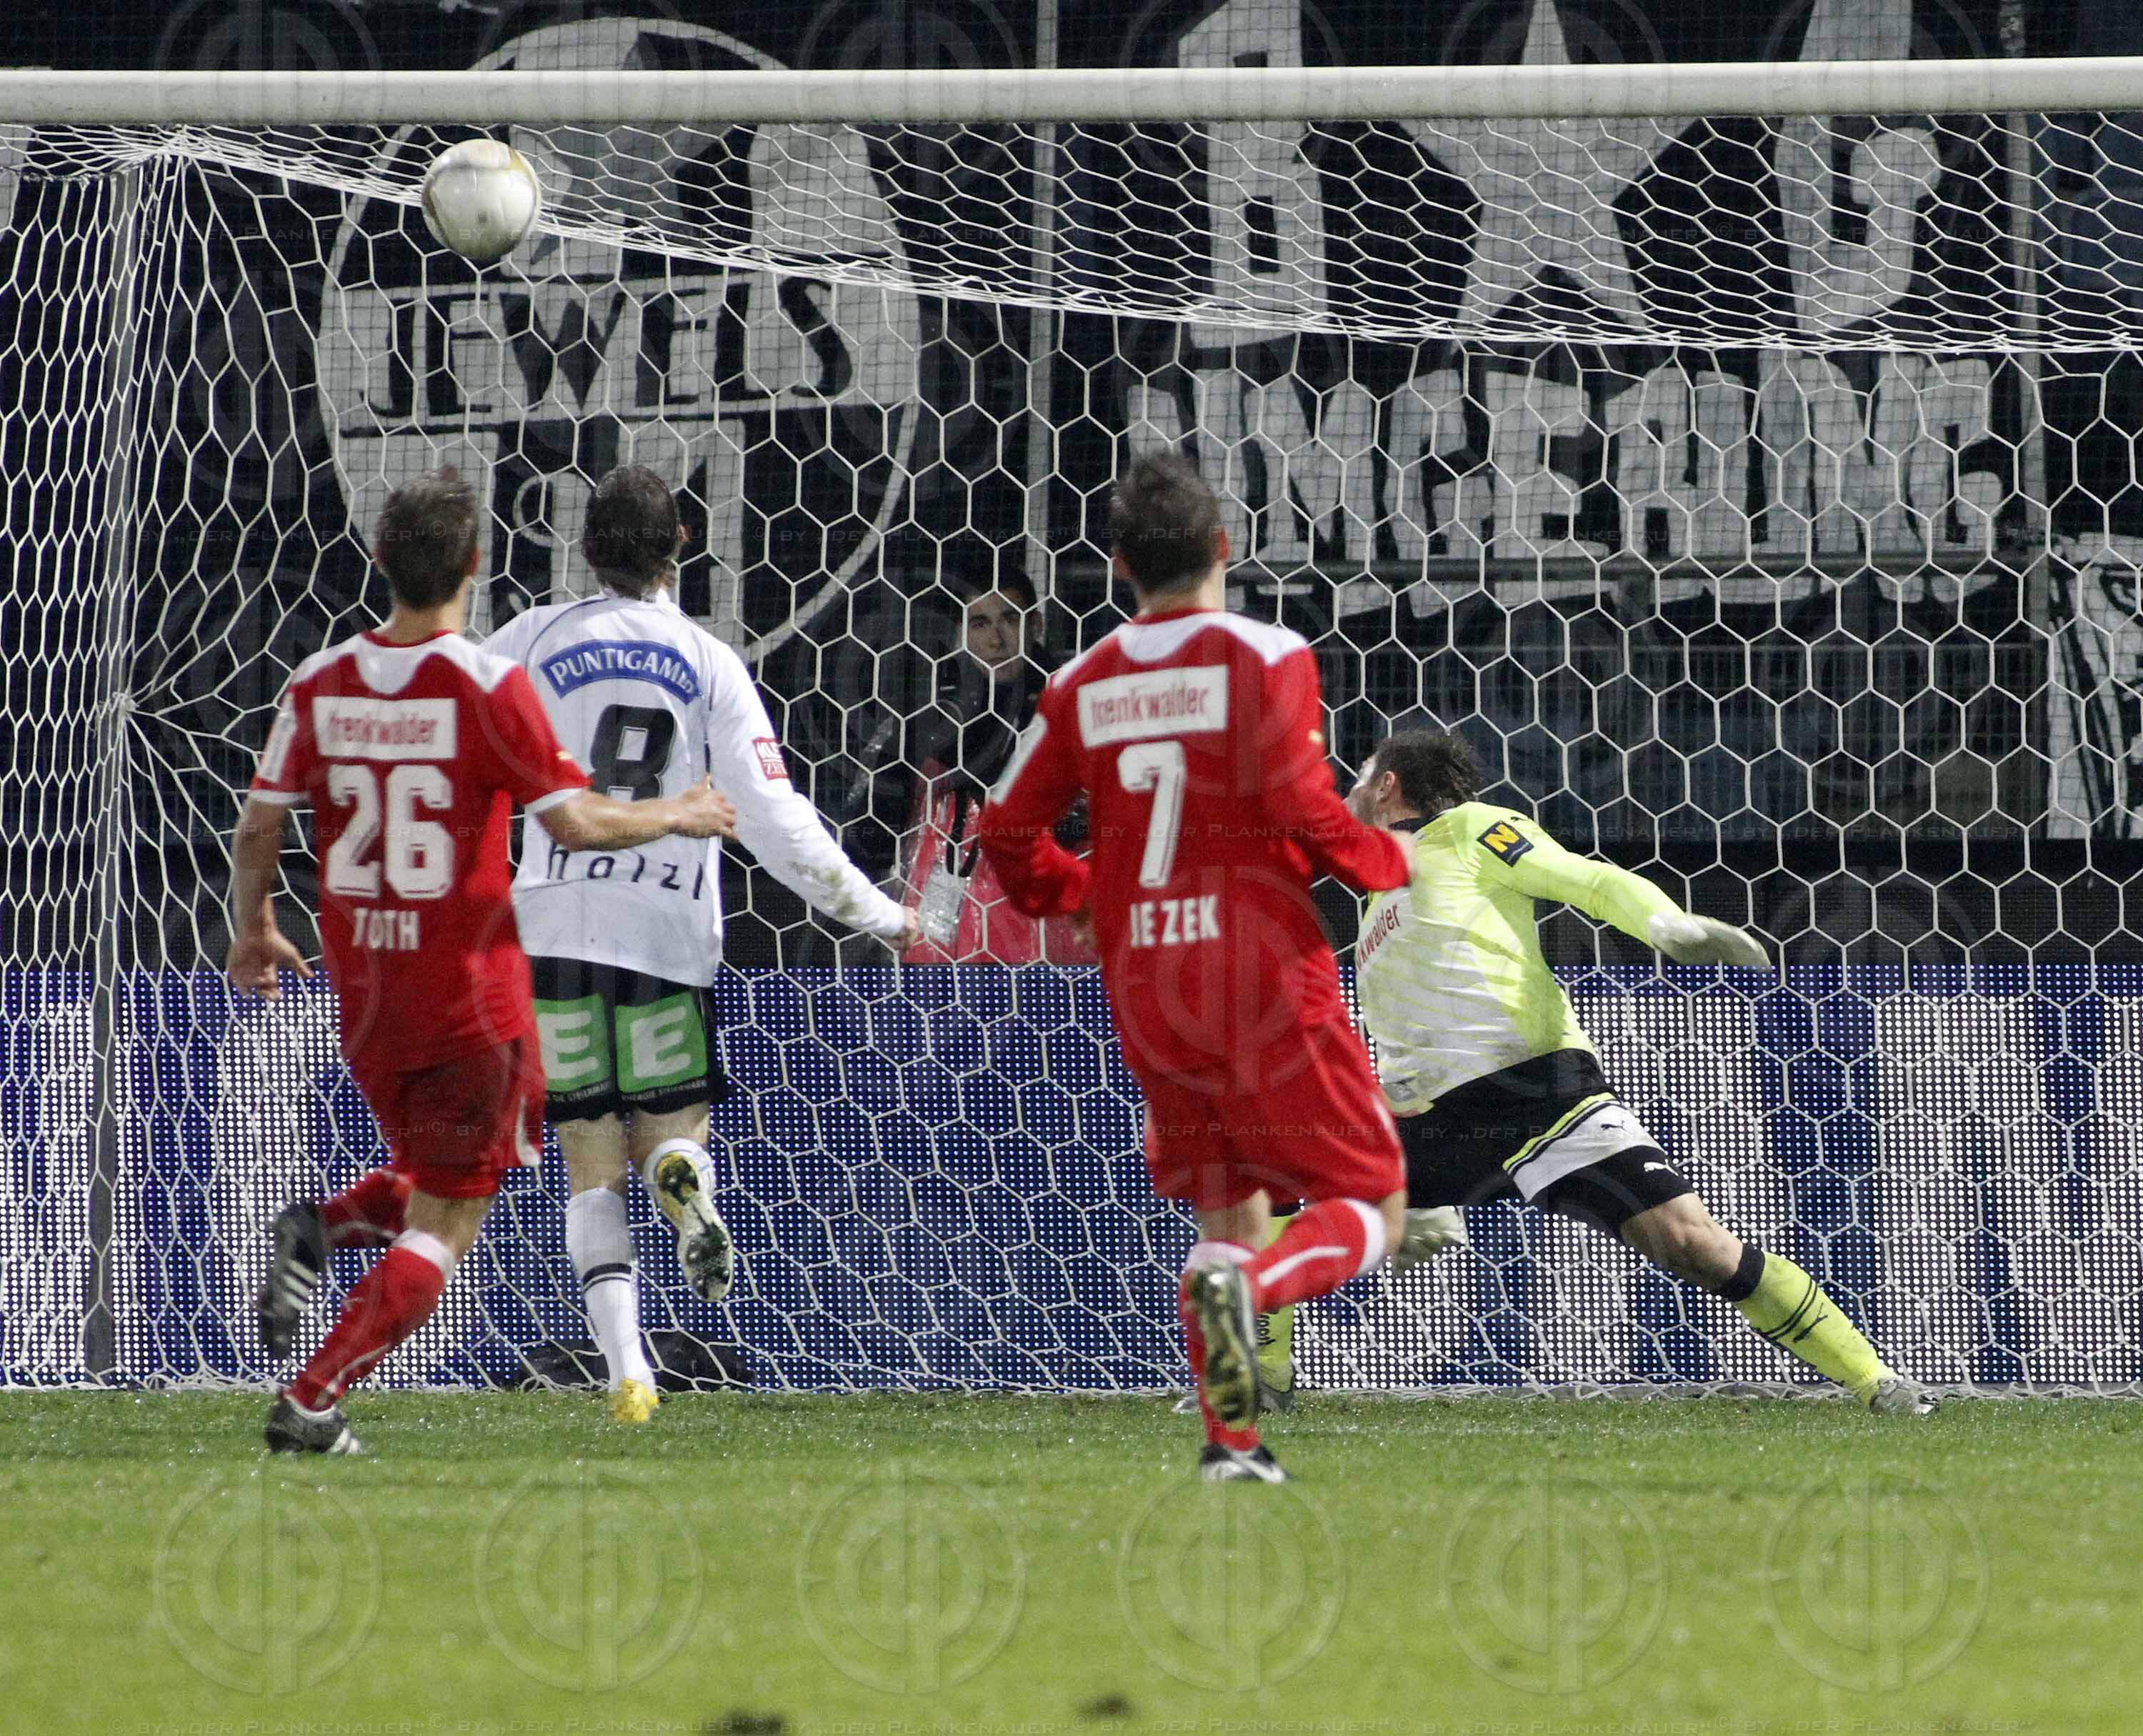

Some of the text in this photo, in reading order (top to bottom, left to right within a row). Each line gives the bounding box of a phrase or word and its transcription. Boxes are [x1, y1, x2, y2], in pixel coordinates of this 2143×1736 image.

[359, 276, 853, 418] JEWELS
[327, 764, 454, 899] 26
[1117, 740, 1187, 889] 7
[1484, 823, 1520, 853] N
[351, 907, 420, 951] TOTH
[536, 1009, 599, 1079] E
[629, 1005, 692, 1079] E
